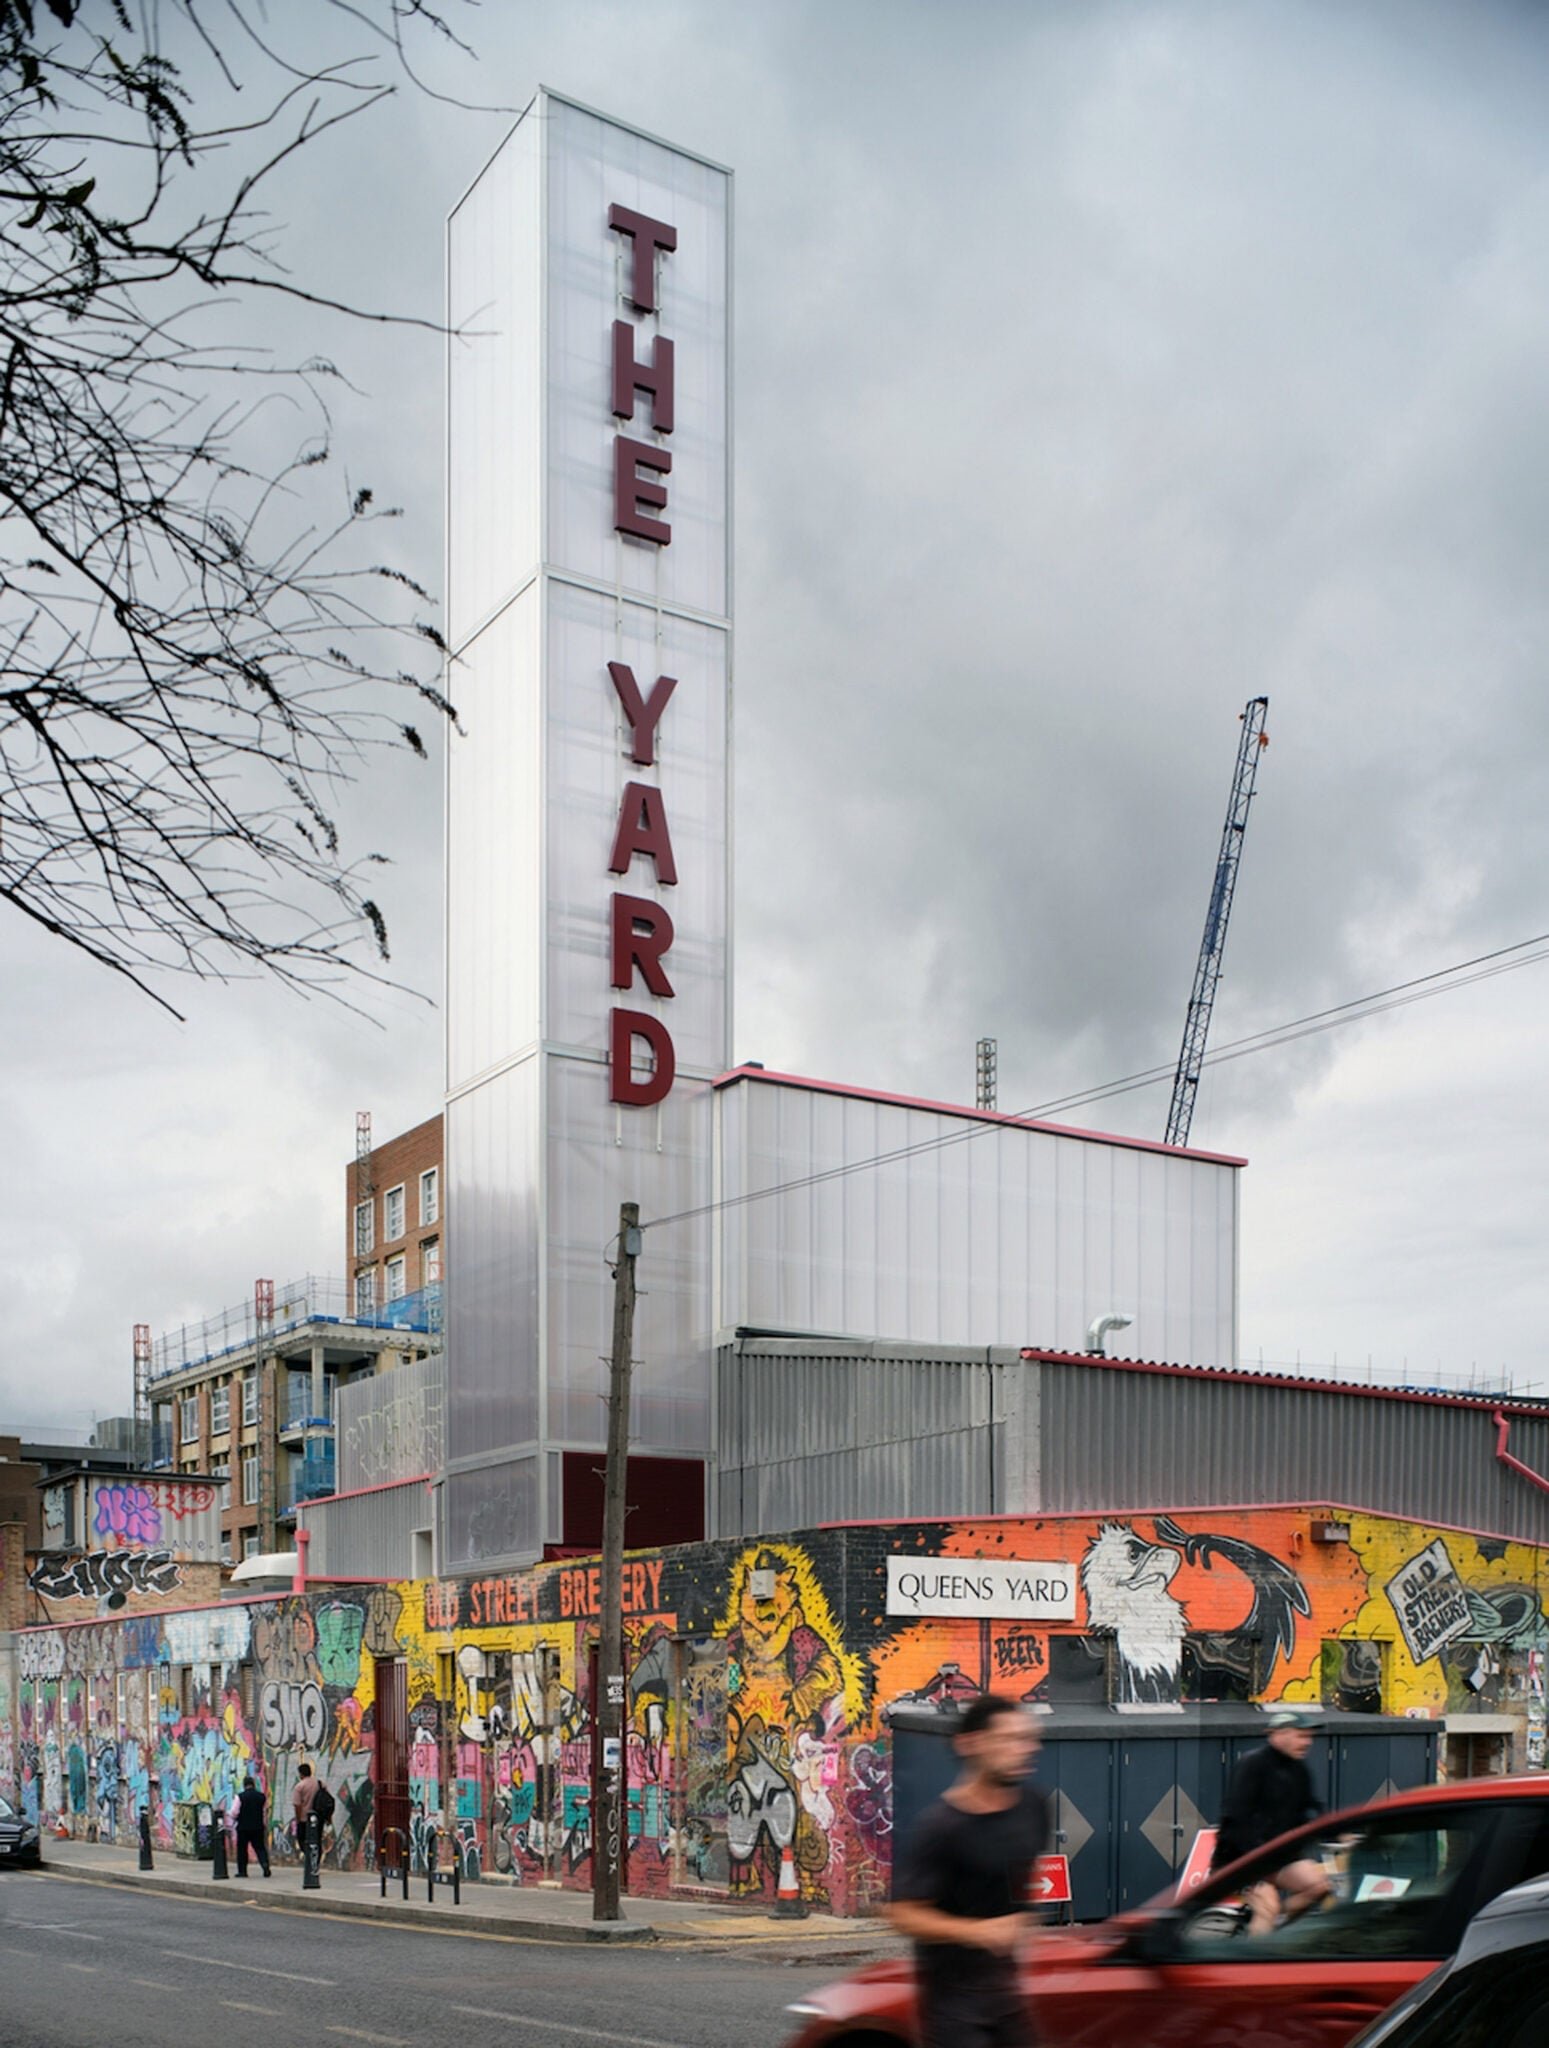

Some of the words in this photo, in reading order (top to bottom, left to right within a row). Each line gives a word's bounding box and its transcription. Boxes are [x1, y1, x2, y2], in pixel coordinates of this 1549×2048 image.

[608, 203, 678, 546] THE
[608, 660, 678, 1106] YARD
[470, 1577, 540, 1626] STREET
[560, 1560, 664, 1617] BREERY
[899, 1573, 993, 1601] QUEENS
[1006, 1577, 1068, 1602] YARD
[1402, 1560, 1438, 1598] OLD
[995, 1634, 1045, 1668] BEER
